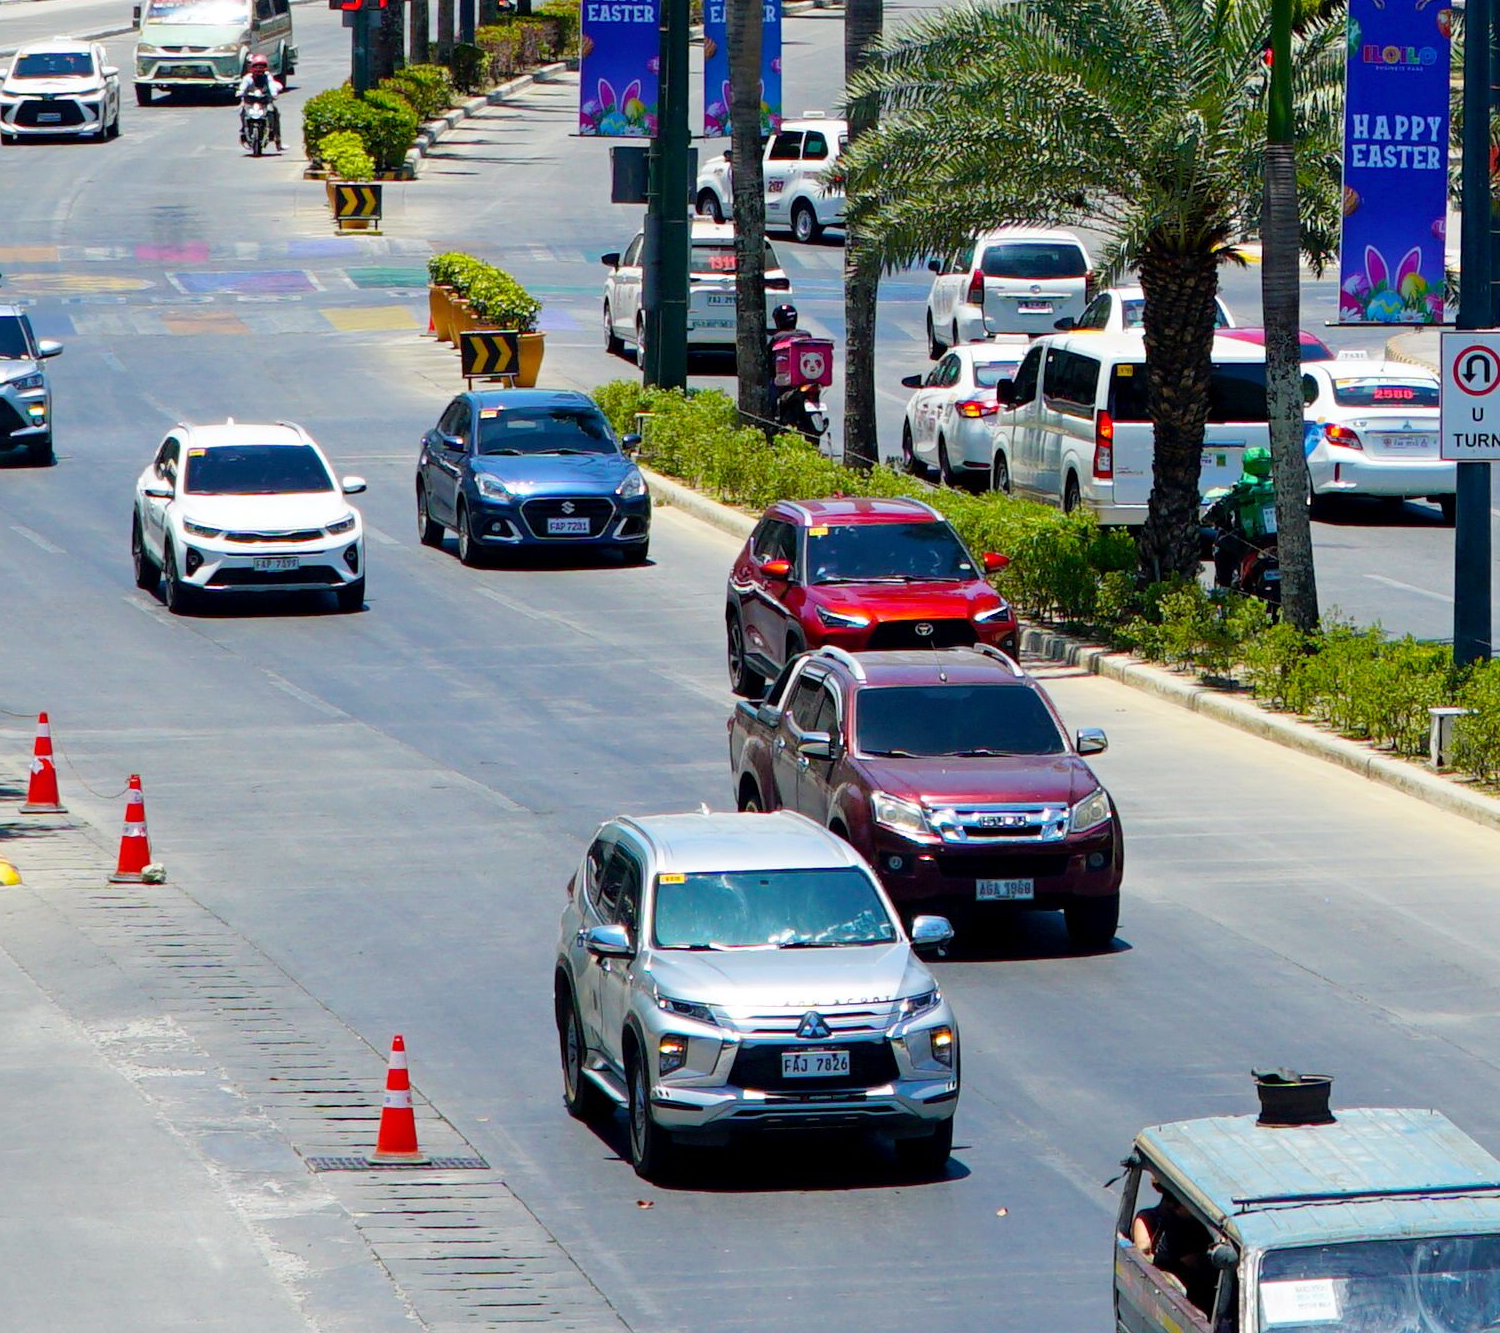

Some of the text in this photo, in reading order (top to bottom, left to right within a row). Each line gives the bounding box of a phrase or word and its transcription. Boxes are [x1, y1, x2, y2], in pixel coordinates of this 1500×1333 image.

[587, 4, 655, 23] EASTER
[1363, 45, 1438, 66] ILOILO
[1353, 114, 1442, 142] HAPPY
[1352, 144, 1441, 170] EASTER
[1472, 408, 1484, 422] U
[784, 1058, 848, 1073] FAJ 7826
